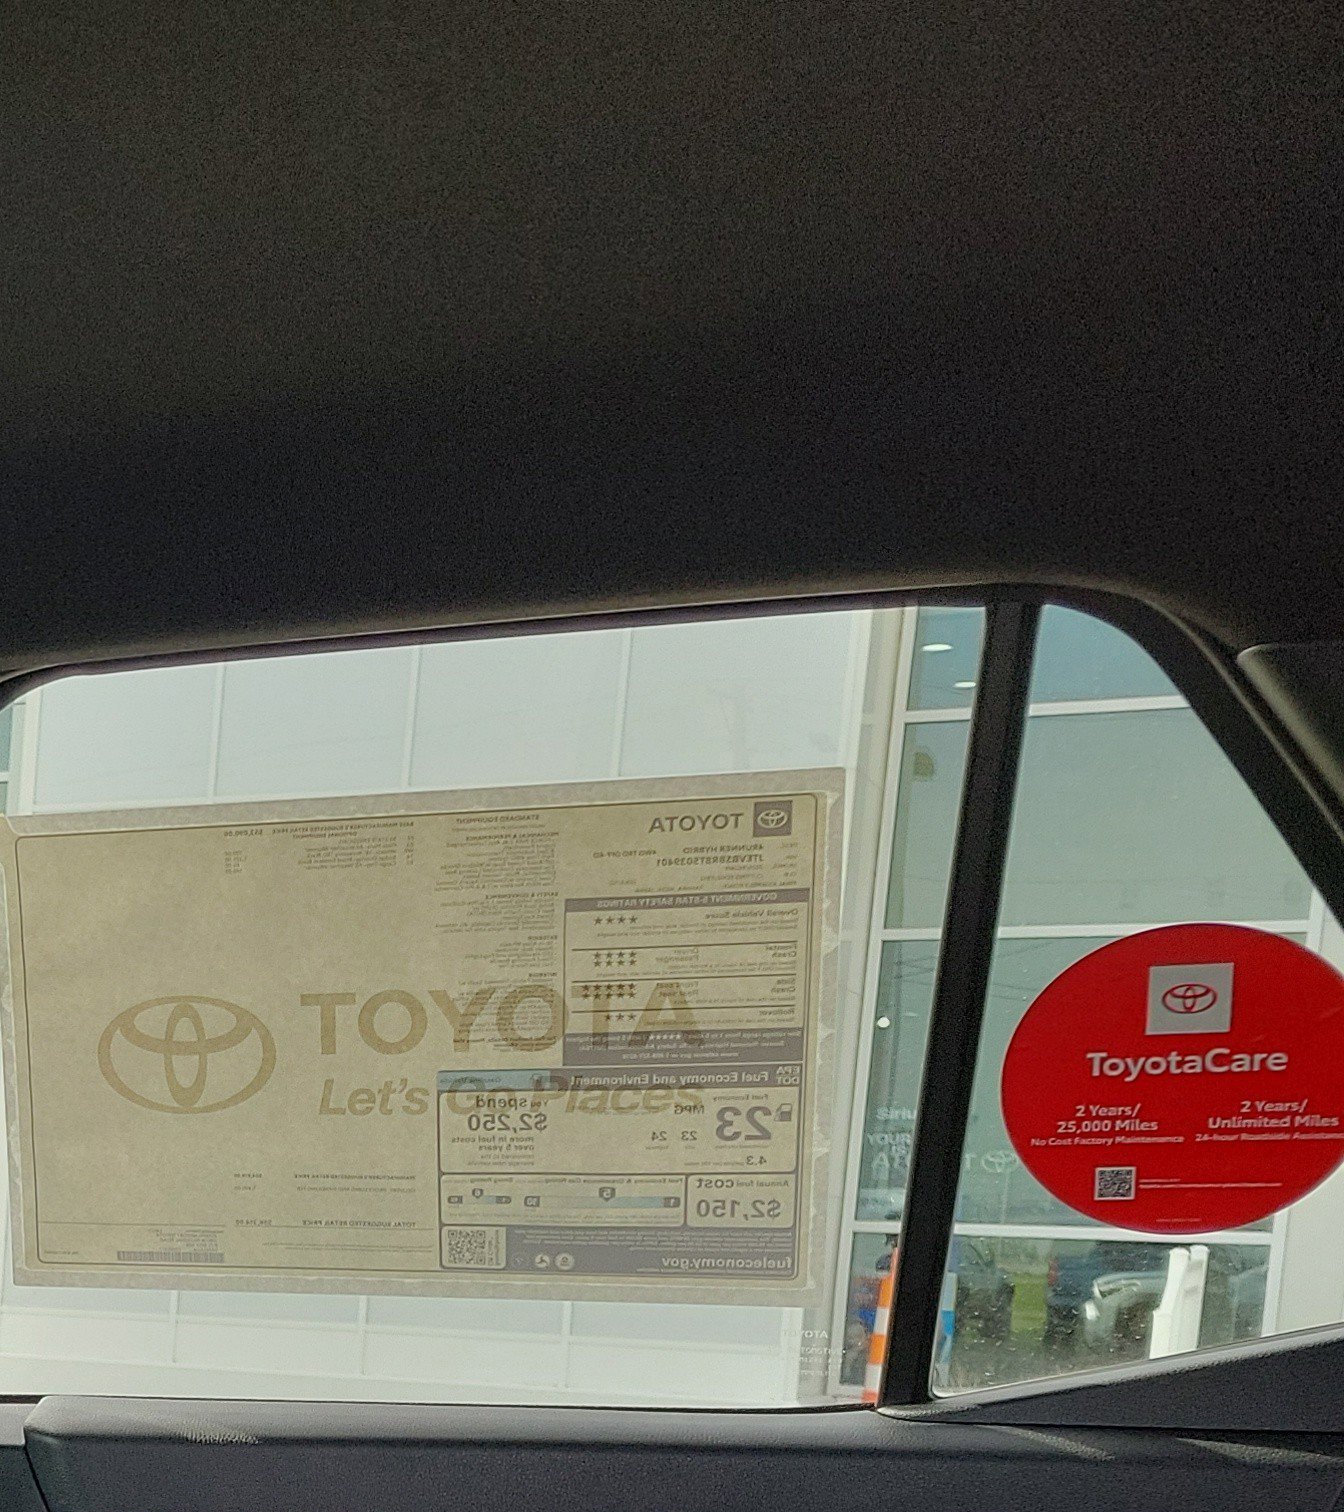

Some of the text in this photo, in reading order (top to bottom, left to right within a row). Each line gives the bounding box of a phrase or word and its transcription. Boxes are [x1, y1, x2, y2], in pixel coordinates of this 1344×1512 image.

[300, 983, 705, 1055] TOYOTA
[1085, 1047, 1289, 1082] ToyotaCare
[319, 1078, 429, 1116] Let's
[527, 1075, 704, 1116] Places
[1075, 1103, 1141, 1117] 2 Years/
[1240, 1098, 1307, 1113] 2 Years/
[1057, 1119, 1159, 1134] 25,000 Miles
[1208, 1114, 1339, 1129] Unlimited Miles
